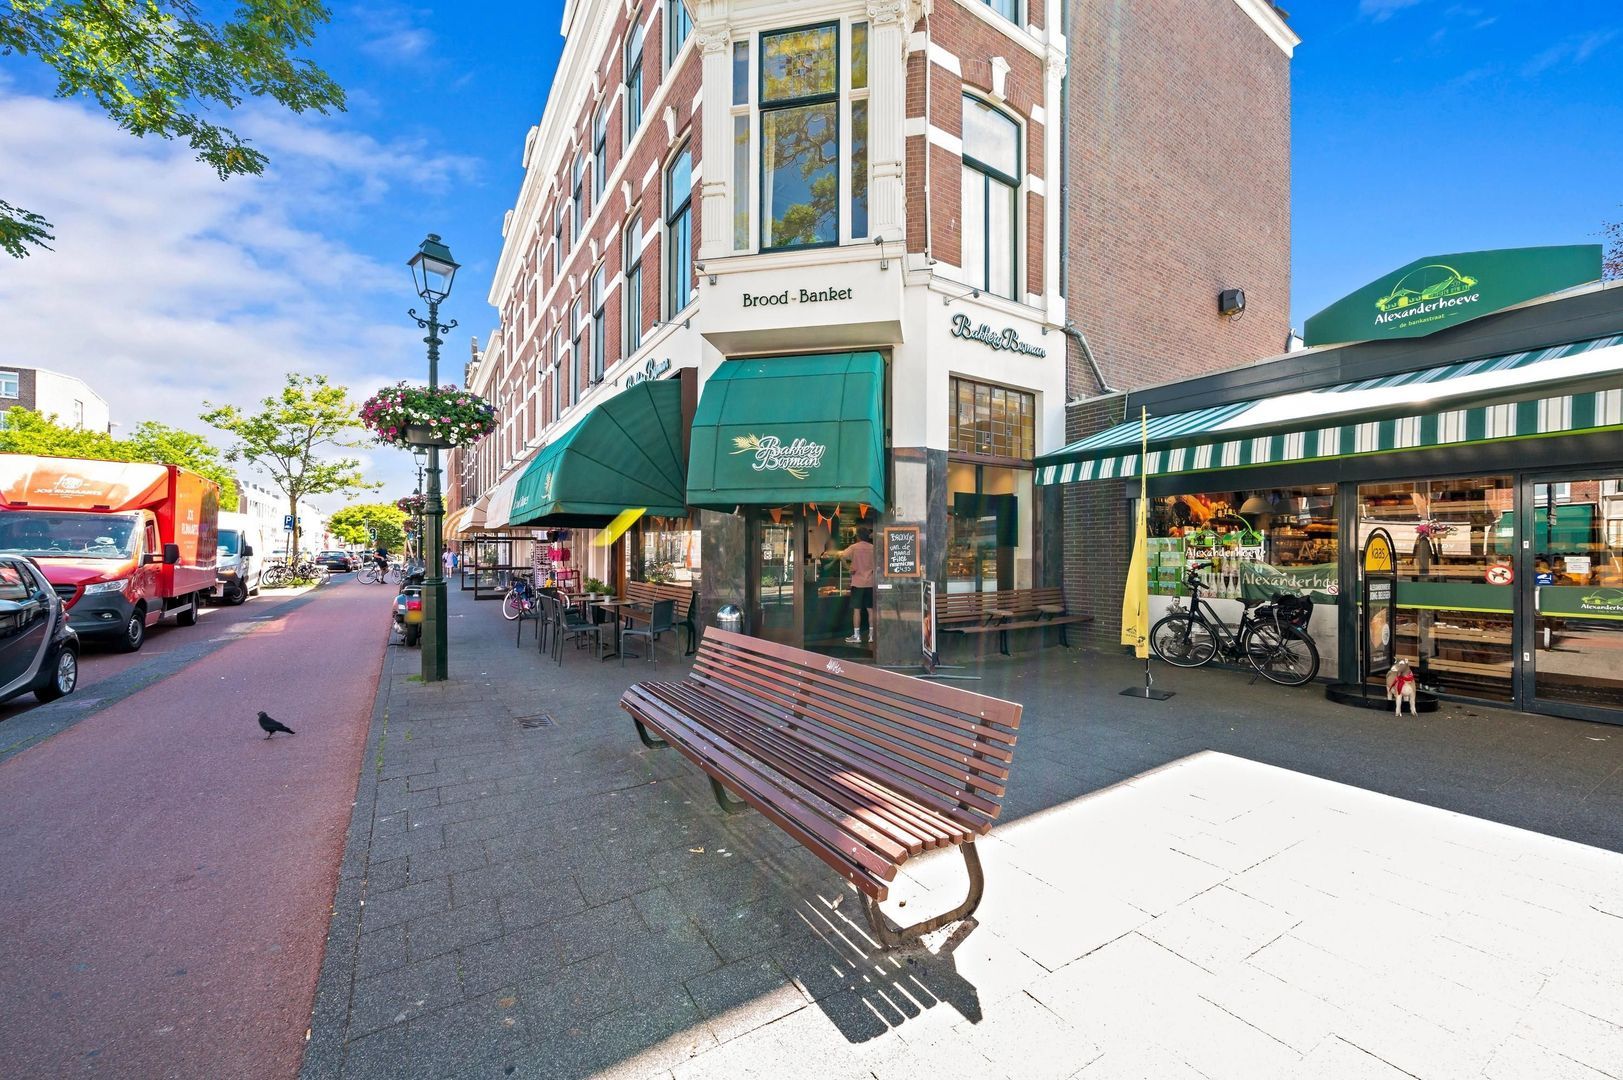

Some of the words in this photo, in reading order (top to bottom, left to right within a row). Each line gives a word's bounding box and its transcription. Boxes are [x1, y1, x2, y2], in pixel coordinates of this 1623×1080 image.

[742, 290, 789, 308] Brood
[799, 286, 853, 304] Banket
[1374, 293, 1480, 326] Alexanderhoeve
[951, 313, 1001, 351] Bakkery
[1000, 327, 1046, 359] Bosman
[755, 435, 826, 461] Bakkery
